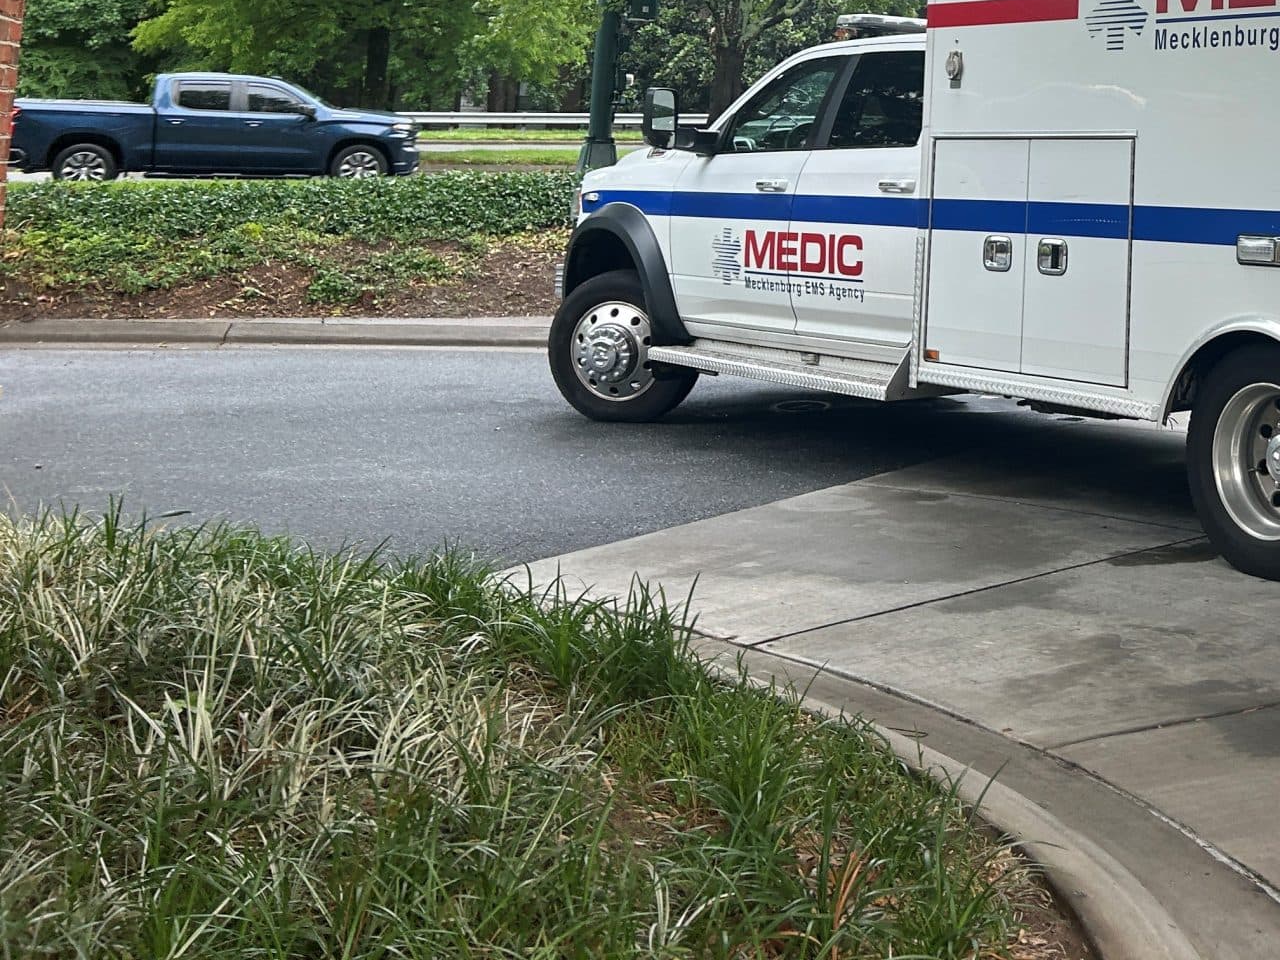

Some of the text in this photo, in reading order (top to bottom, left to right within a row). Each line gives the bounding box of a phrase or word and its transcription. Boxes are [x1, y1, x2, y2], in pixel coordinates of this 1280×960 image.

[1154, 24, 1280, 51] Mecklenburg
[744, 229, 864, 277] MEDIC
[744, 276, 865, 303] Mecklenburg EMS Agency
